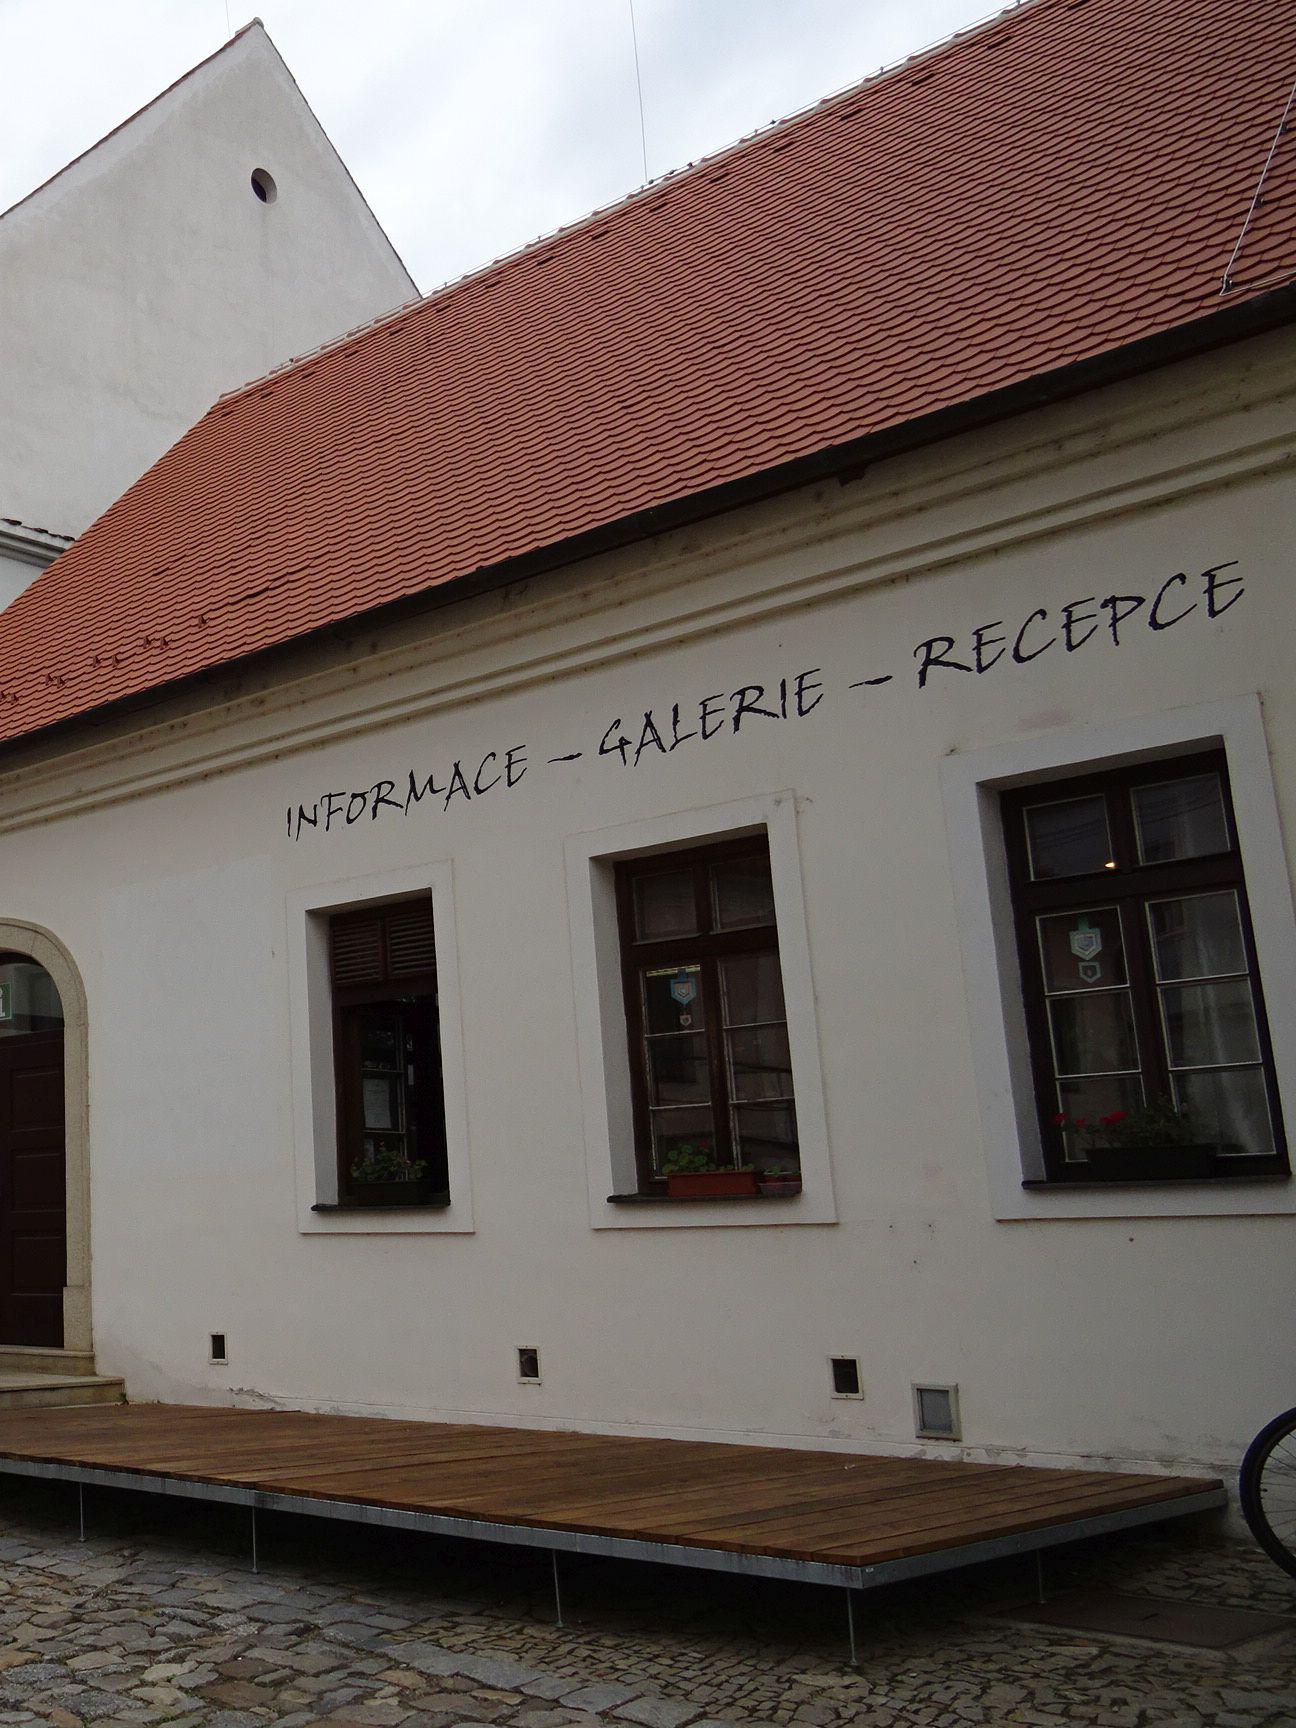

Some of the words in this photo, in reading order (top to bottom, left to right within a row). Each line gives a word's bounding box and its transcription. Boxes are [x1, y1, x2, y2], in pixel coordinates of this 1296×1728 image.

[286, 744, 528, 842] INFORMACE
[598, 668, 825, 768] GALERIE
[913, 559, 1246, 690] RECEPCE
